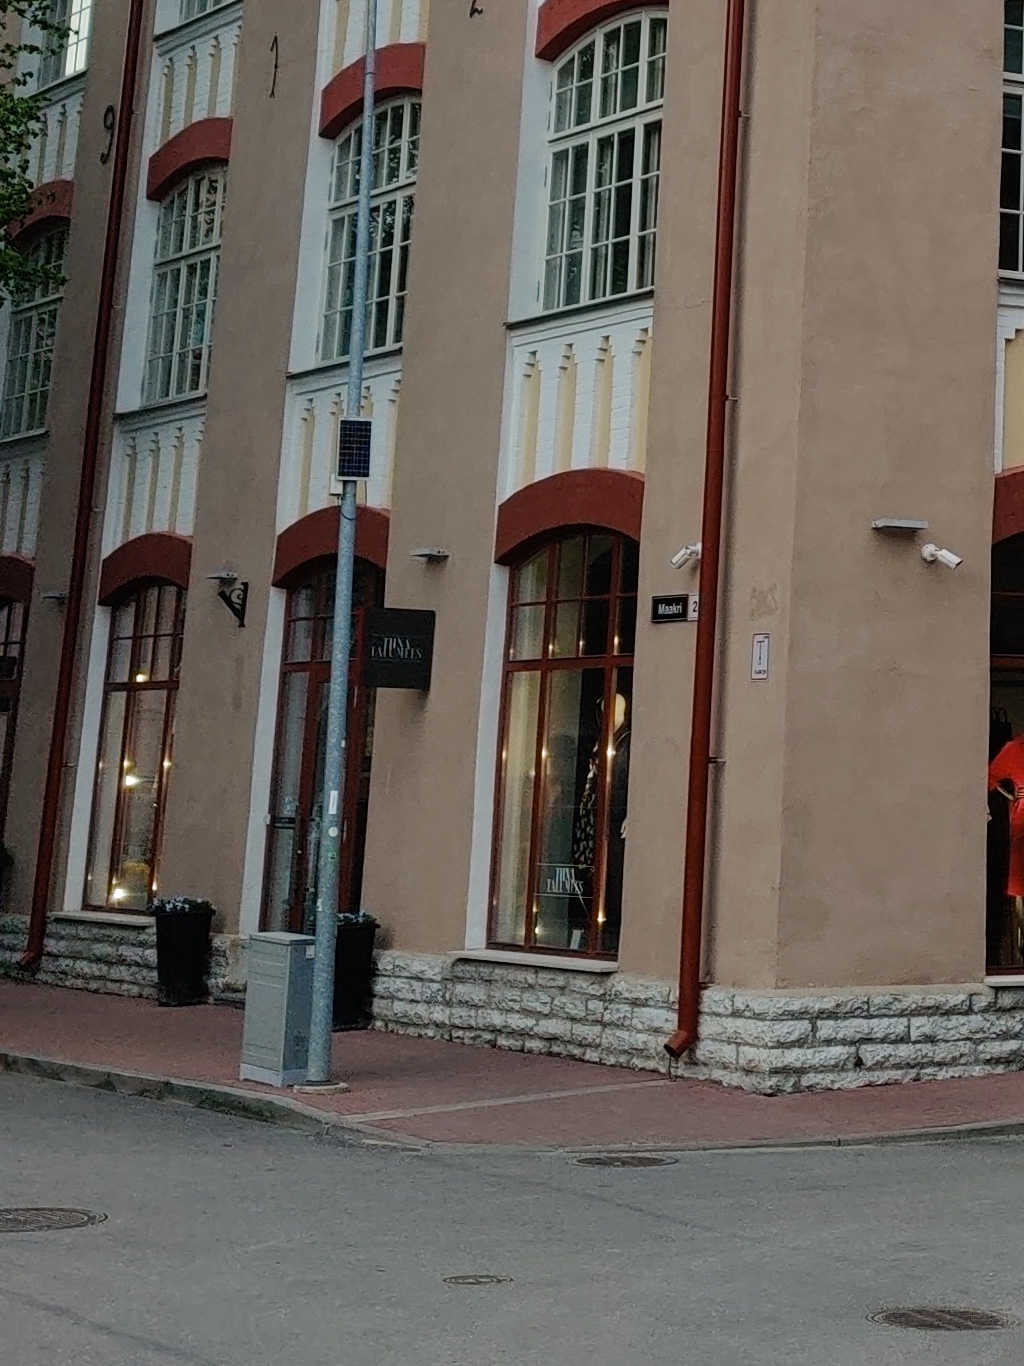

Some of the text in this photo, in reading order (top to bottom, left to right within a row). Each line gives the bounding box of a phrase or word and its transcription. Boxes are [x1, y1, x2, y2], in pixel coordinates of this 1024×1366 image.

[269, 34, 279, 99] 1
[100, 104, 116, 165] 9
[657, 602, 683, 615] Maakri
